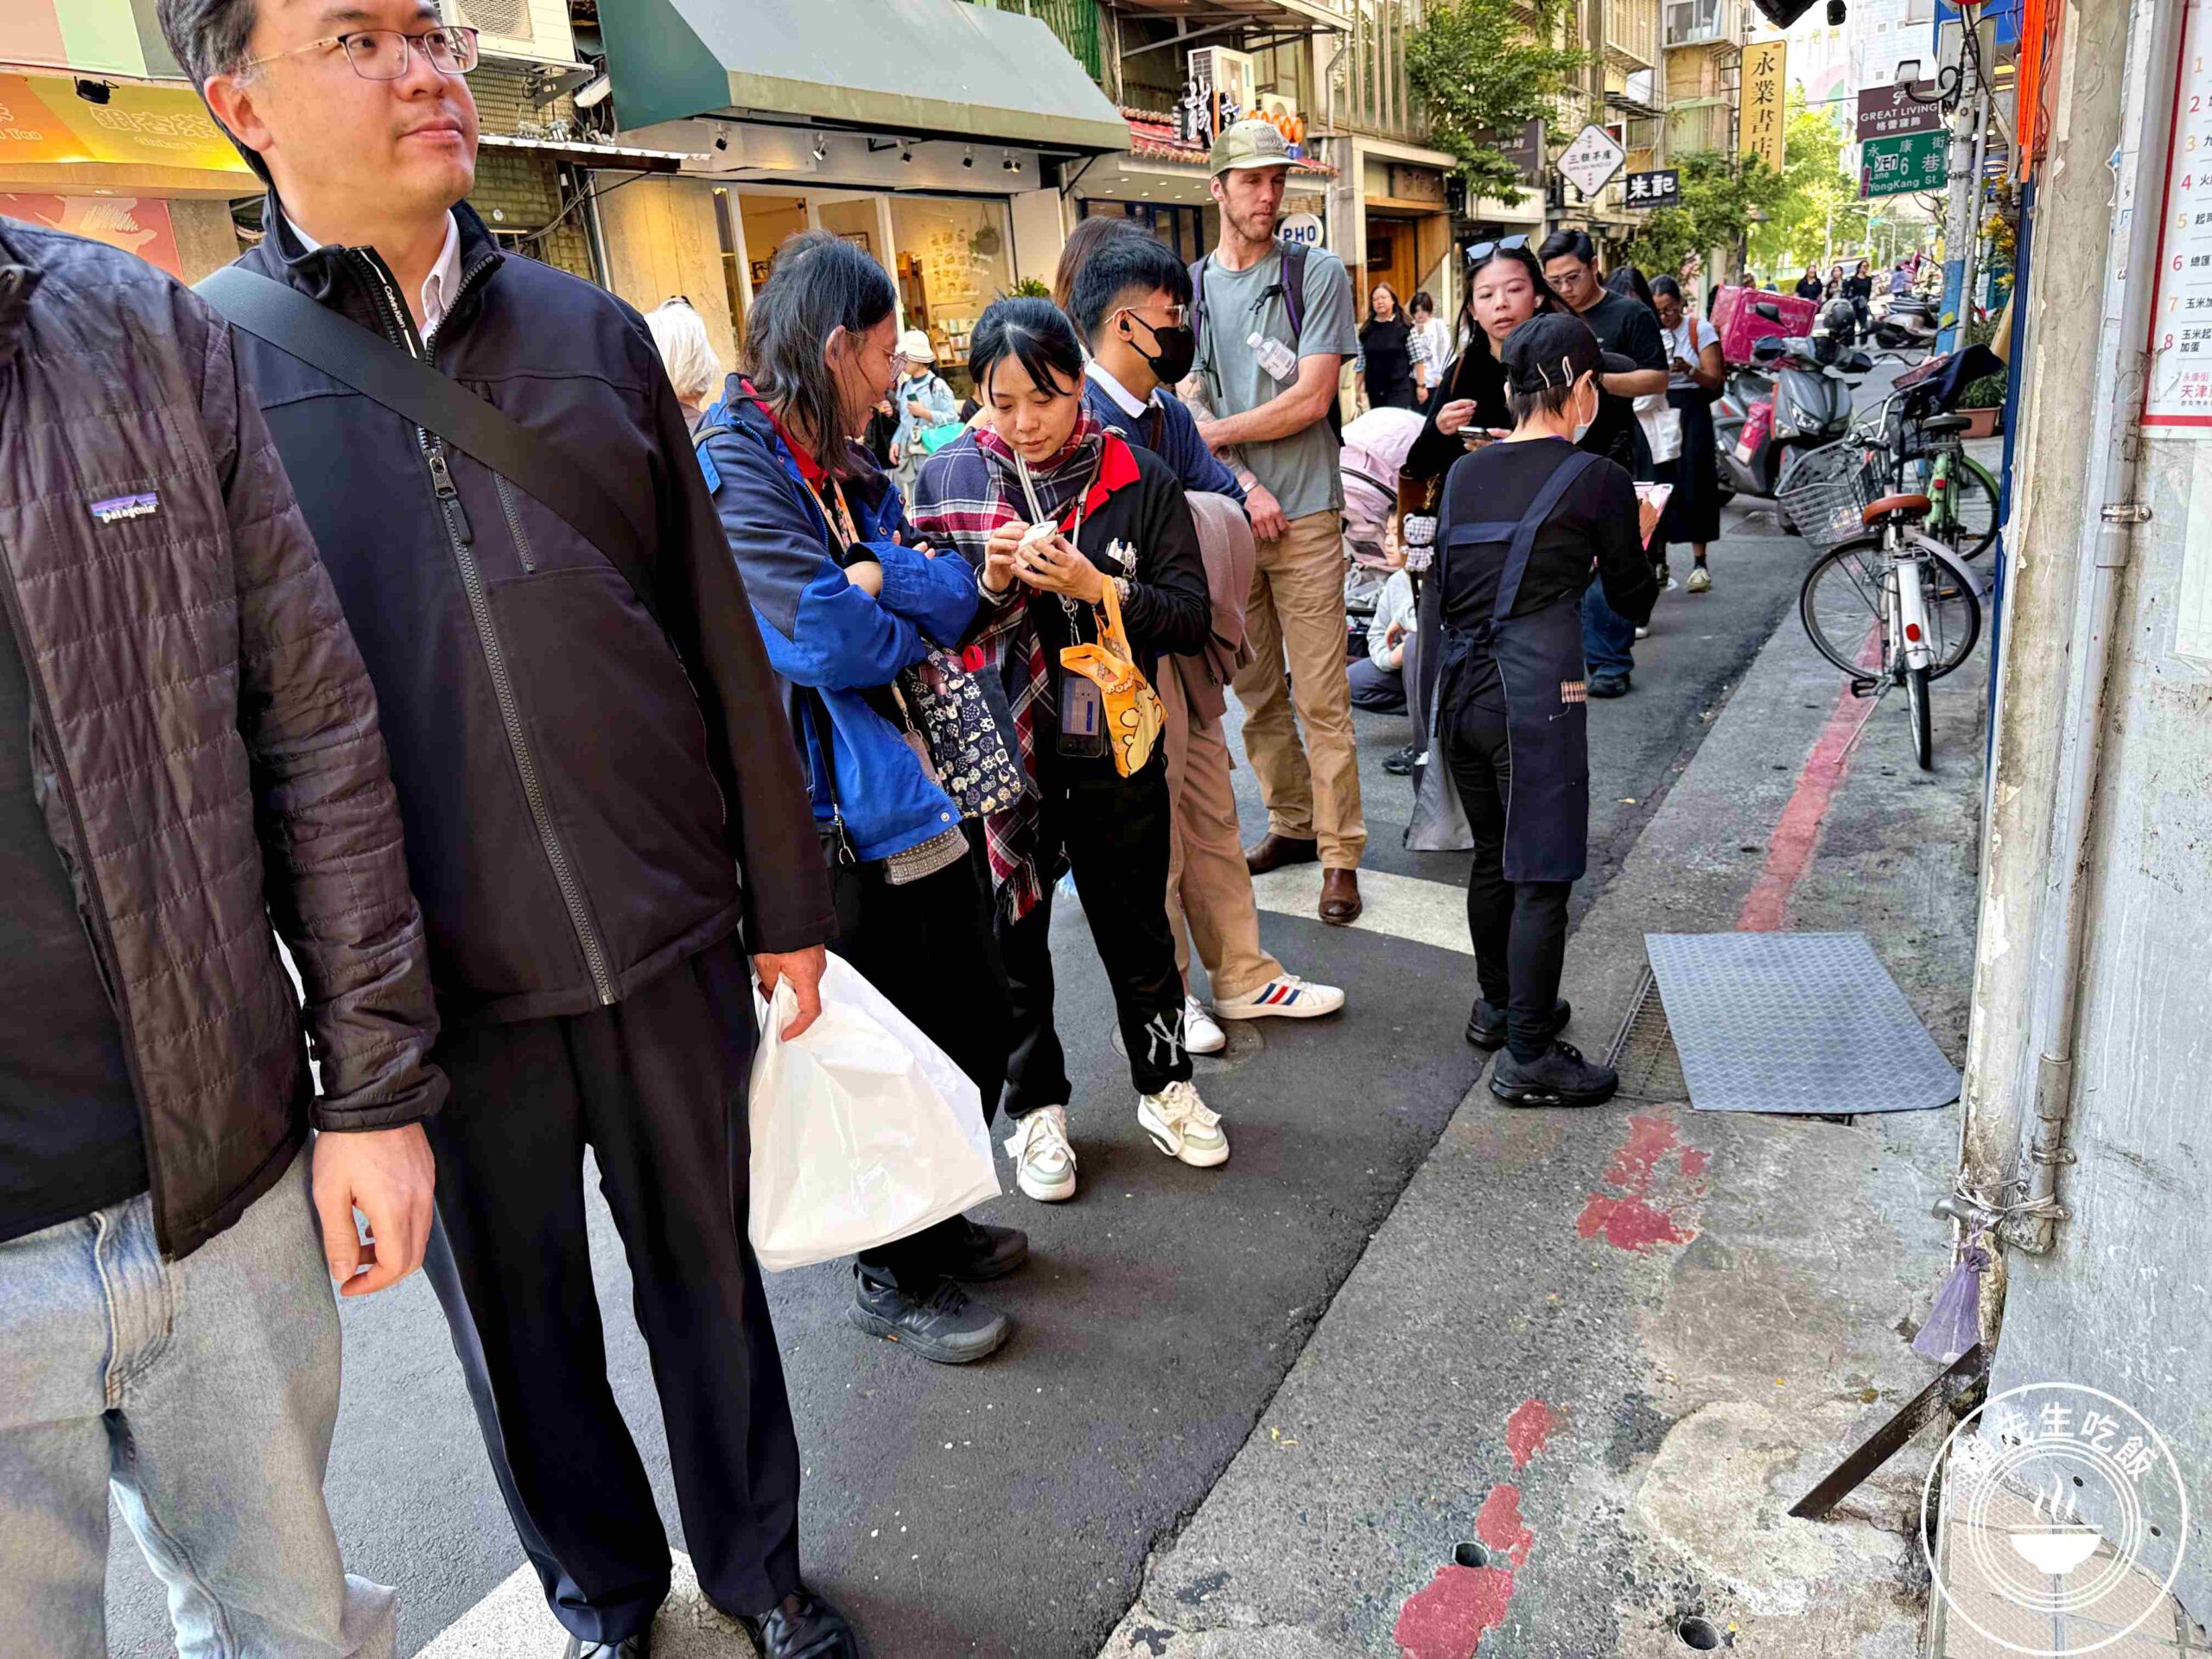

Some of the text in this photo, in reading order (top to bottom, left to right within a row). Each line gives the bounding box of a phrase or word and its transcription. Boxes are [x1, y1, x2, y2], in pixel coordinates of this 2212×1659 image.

[2194, 57, 2203, 73] 1
[2189, 95, 2200, 113] 2
[1860, 103, 1937, 122] GREAT LIVING
[1866, 136, 1946, 157] 永康街
[2186, 136, 2196, 152] 3
[1870, 172, 1890, 181] Lane
[2181, 175, 2192, 191] 4
[1628, 175, 1676, 200] 朱記
[1869, 179, 1920, 192] YongKang
[2177, 213, 2188, 229] 5
[1283, 225, 1316, 242] PHO
[2172, 255, 2183, 271] 6
[385, 285, 406, 328] Calvin Klein
[2170, 297, 2178, 312] 7
[2164, 334, 2173, 350] 8
[2180, 341, 2201, 353] 加蛋
[102, 504, 156, 524] patagonia
